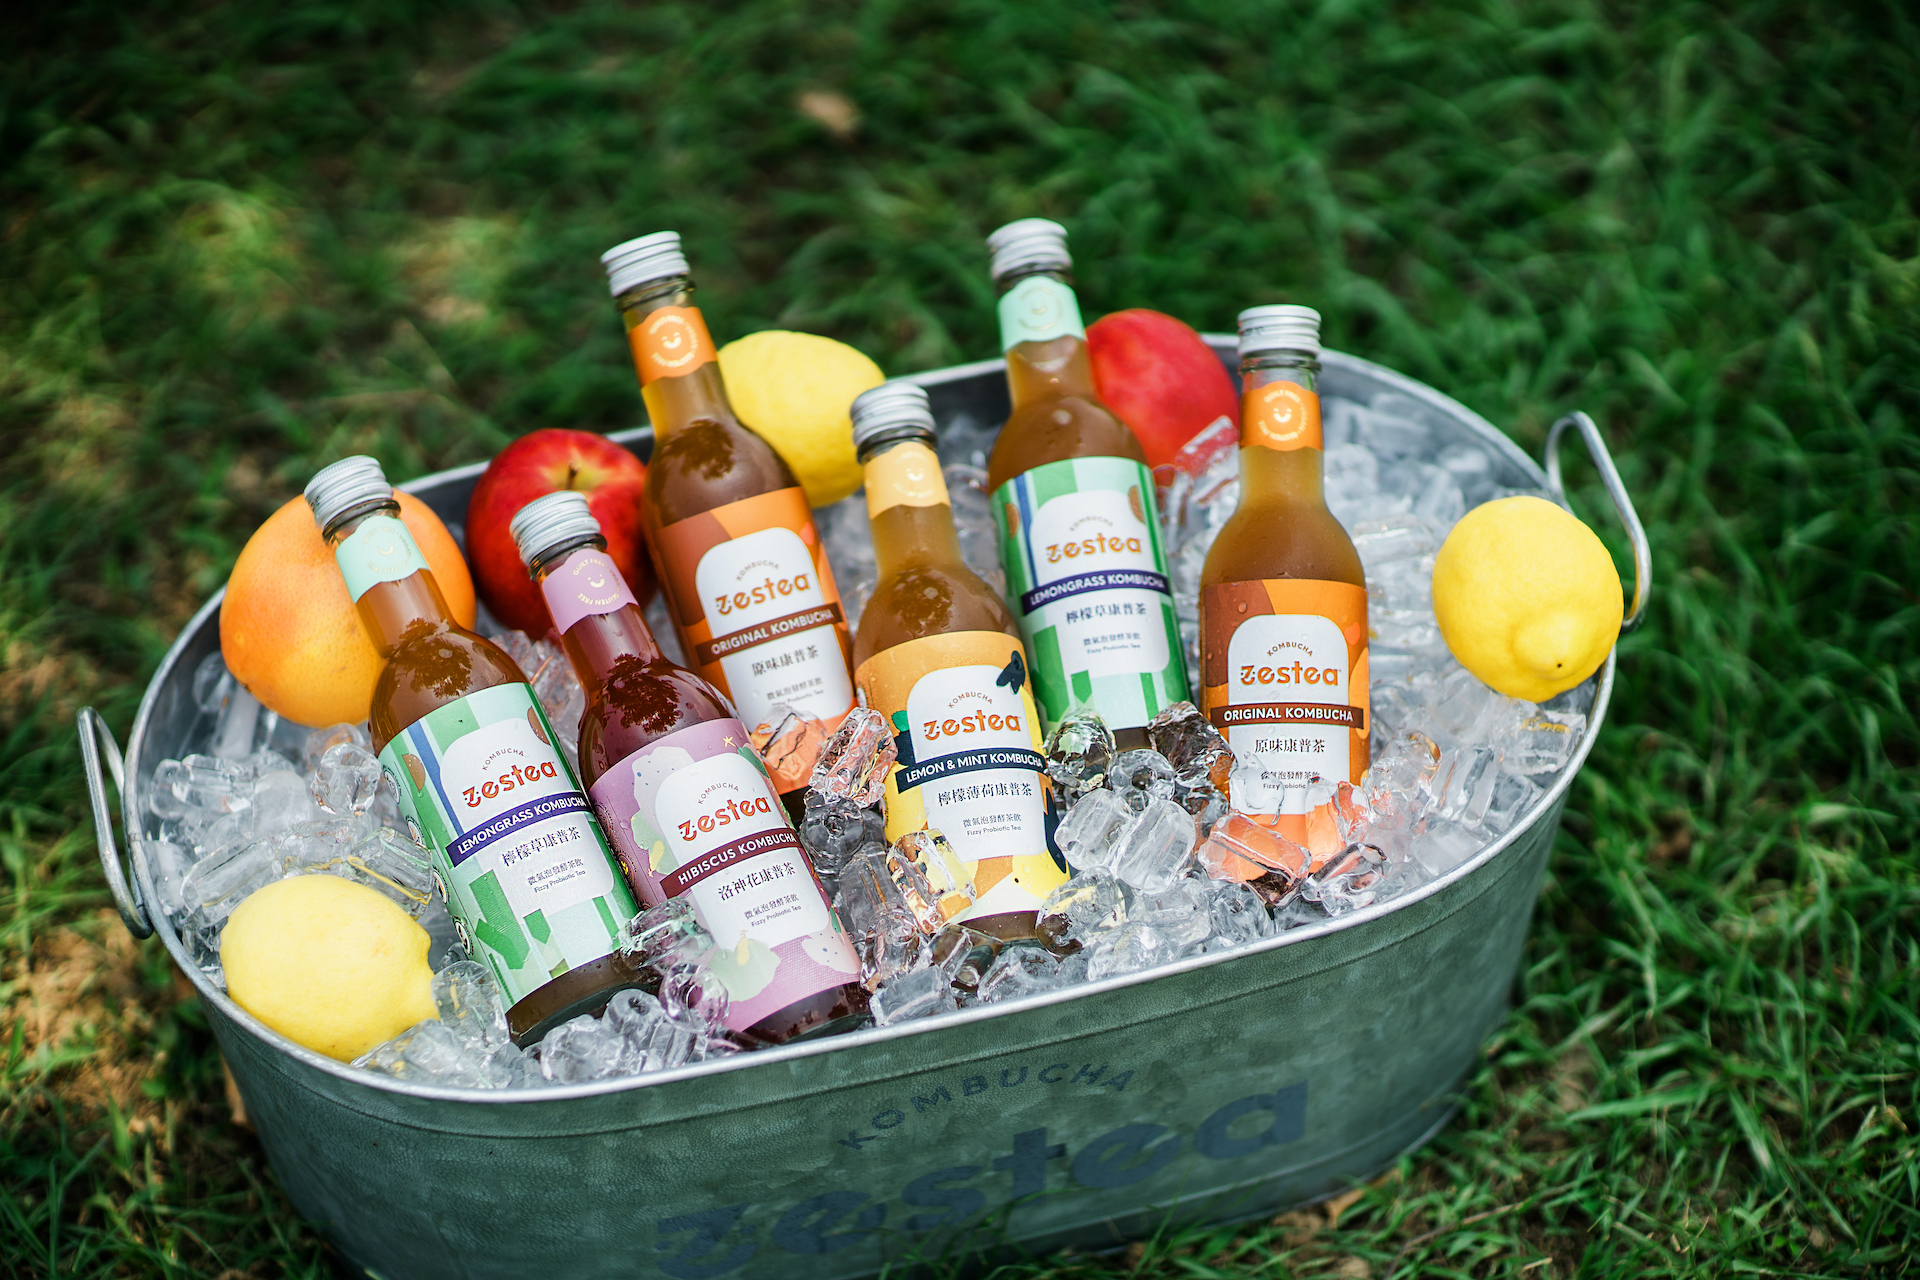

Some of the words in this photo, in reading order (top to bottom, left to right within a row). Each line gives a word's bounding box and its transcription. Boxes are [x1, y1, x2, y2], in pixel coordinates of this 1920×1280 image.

[1046, 533, 1141, 563] zestea
[736, 560, 779, 581] KOMBUCHA
[715, 573, 810, 616] zestea
[1030, 574, 1106, 606] LEMONGRASS
[1107, 573, 1166, 588] KOMBUCHA
[711, 627, 770, 655] ORIGINAL
[771, 609, 834, 635] KOMBUCHA
[752, 645, 819, 677] 原味康普茶
[1267, 641, 1313, 657] KOMBUCHA
[1240, 661, 1338, 687] zestea
[948, 692, 993, 708] KOMBUCHA
[1224, 707, 1282, 722] ORIGINAL
[1285, 707, 1354, 722] KOMBUCHA
[923, 709, 1021, 741] zestea
[482, 747, 525, 771] KOMBUCHA
[1254, 738, 1325, 754] 原味康普茶
[463, 760, 558, 808] zestea
[905, 762, 945, 784] LEMON
[946, 759, 956, 771] &
[957, 753, 988, 769] MINT
[990, 752, 1043, 768] KOMBUCHA
[697, 782, 740, 804] KOMBUCHA
[937, 782, 1033, 807] 檸檬薄荷康普茶
[456, 808, 534, 855] LEMONGRASS
[536, 796, 587, 817] KOMBUCHA
[678, 796, 772, 842] zestea
[983, 826, 1010, 834] Probiotic
[501, 826, 581, 867] 檸檬草康普茶
[677, 849, 737, 885] HIBISCUS
[738, 832, 796, 856] KOMBUCHA
[534, 883, 549, 893] Fizzy
[549, 873, 575, 886] Probiotic
[718, 862, 796, 901] 洛神花康普茶
[751, 918, 766, 927] Fizzy
[766, 908, 791, 921] Probiotic
[837, 1062, 1137, 1152] KOMBUCHA
[656, 1078, 1308, 1279] zestea
